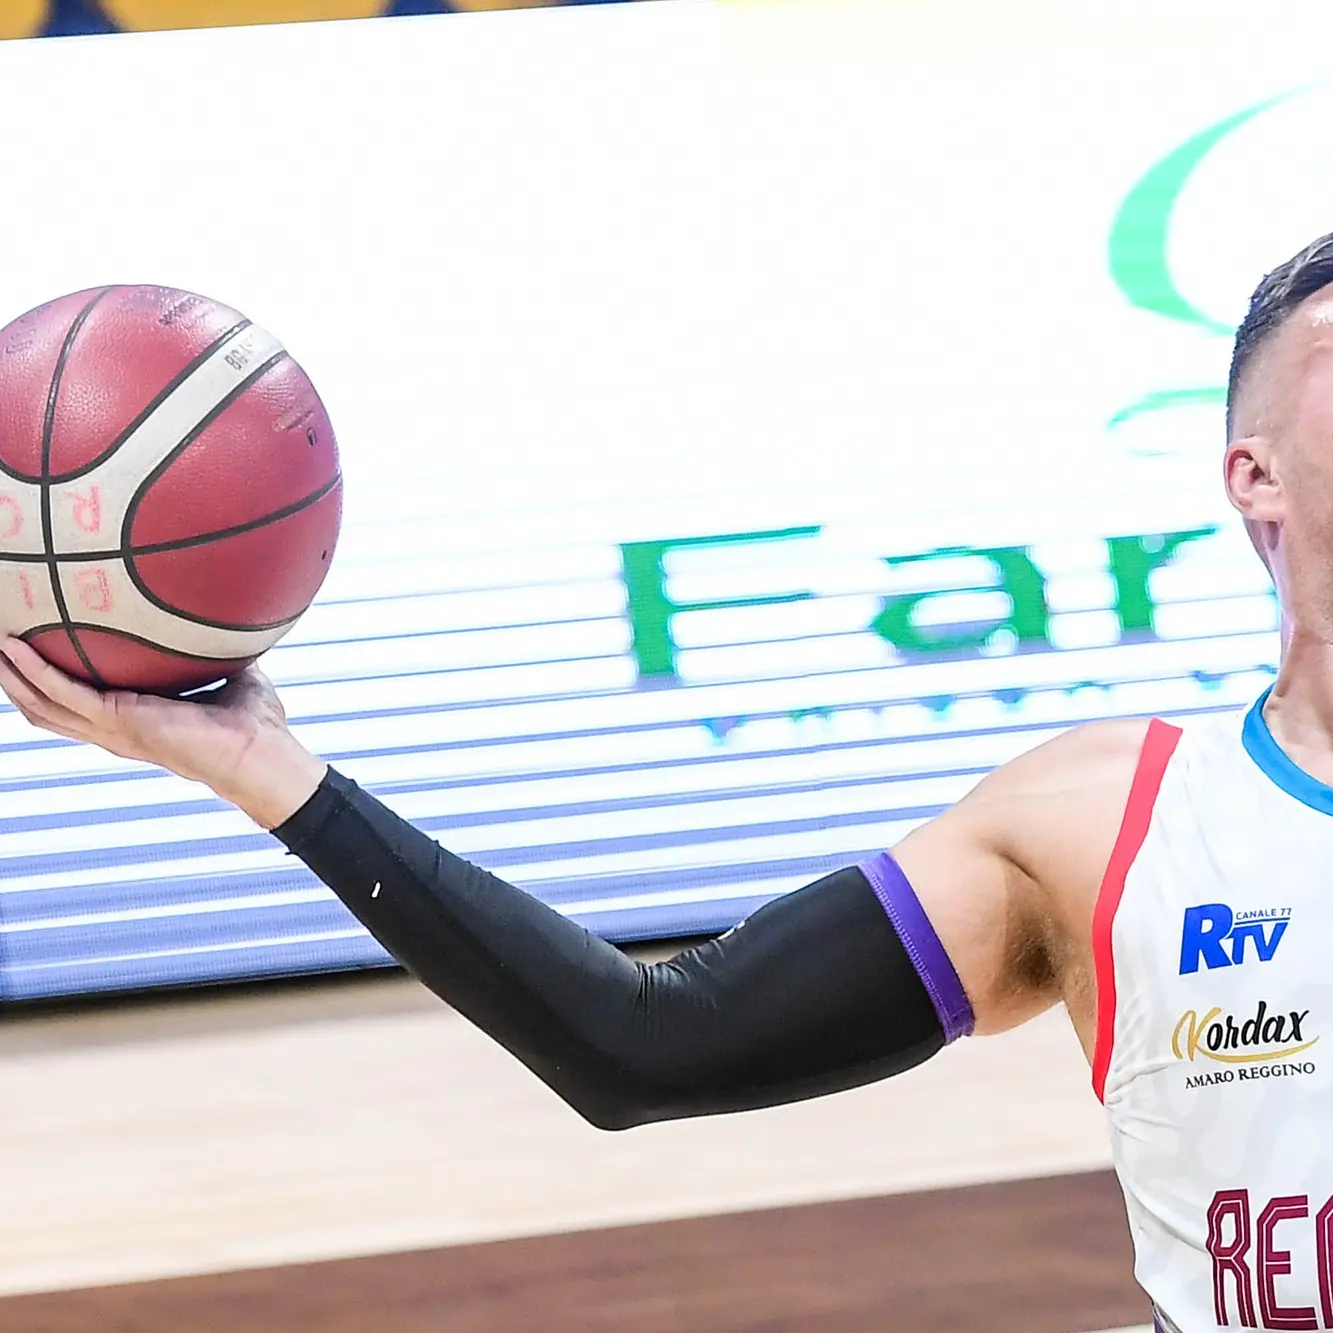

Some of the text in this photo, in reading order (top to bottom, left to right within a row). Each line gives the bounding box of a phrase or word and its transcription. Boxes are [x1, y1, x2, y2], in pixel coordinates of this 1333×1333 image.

[1235, 907, 1292, 921] CANALE 77
[1185, 1062, 1316, 1089] AMARO REGGINO
